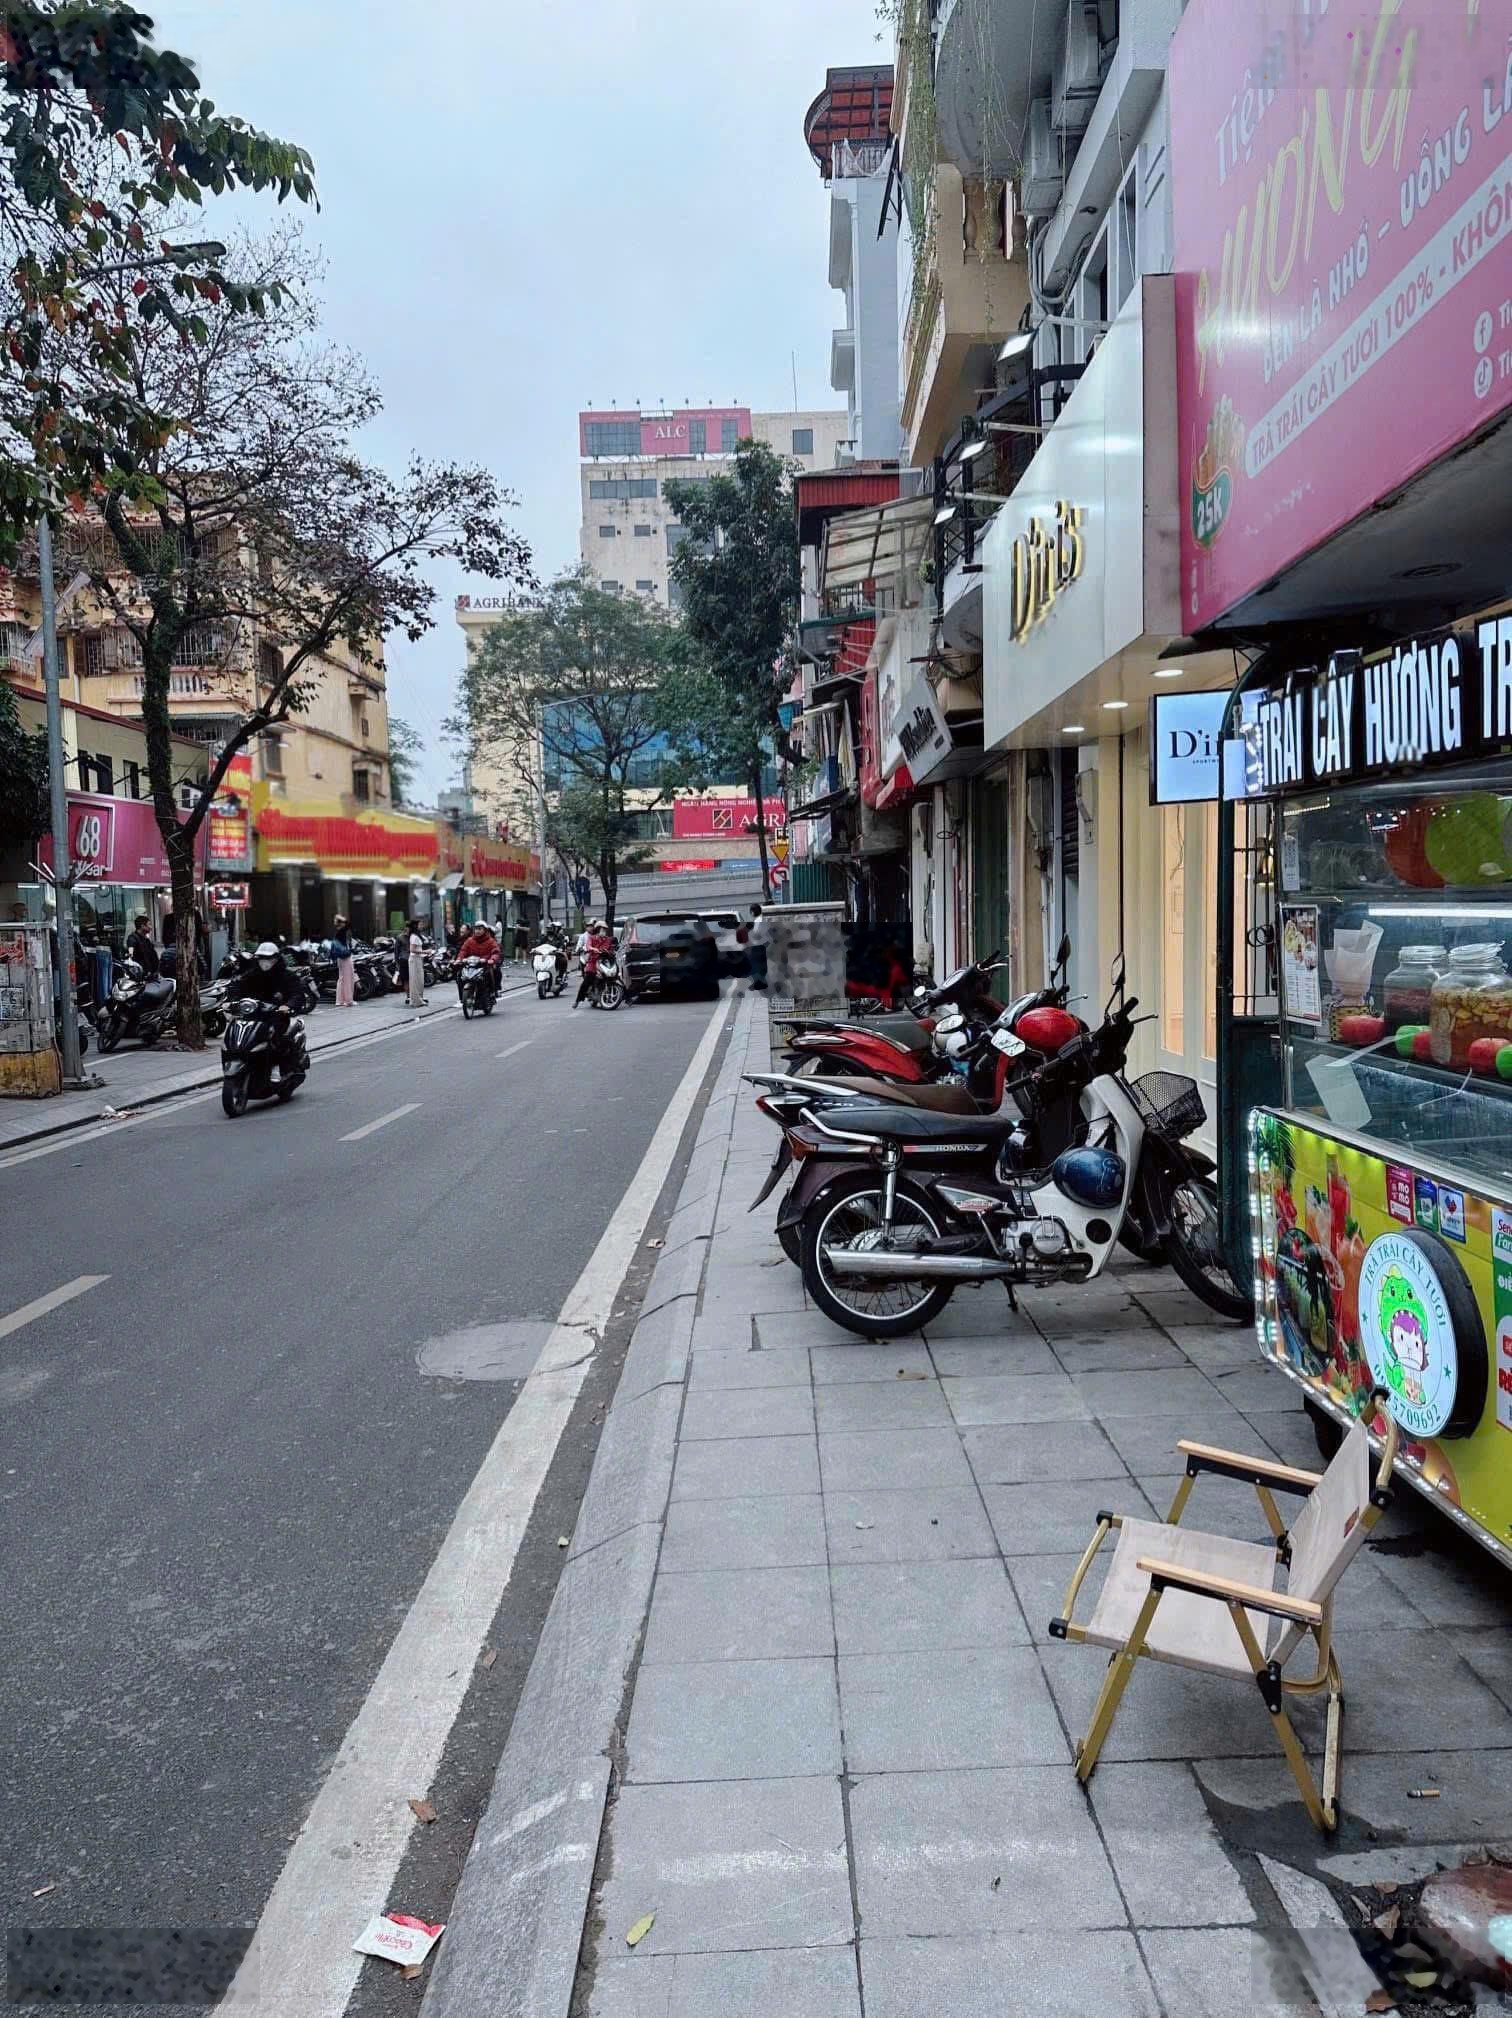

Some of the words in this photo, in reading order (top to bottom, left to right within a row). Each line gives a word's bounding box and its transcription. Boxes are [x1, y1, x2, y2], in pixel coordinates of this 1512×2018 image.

[1400, 128, 1472, 229] UỐNG
[1307, 361, 1337, 413] CÂY
[1385, 265, 1433, 340] 100%
[656, 425, 687, 439] ALC
[1197, 487, 1224, 540] 25K
[1259, 677, 1303, 787] TRÁI
[1312, 660, 1354, 776] CÂY
[1364, 637, 1462, 767] HƯƠNG
[77, 815, 101, 858] 68
[1377, 1239, 1399, 1261] TRÁI
[1402, 1247, 1424, 1274] CÂY
